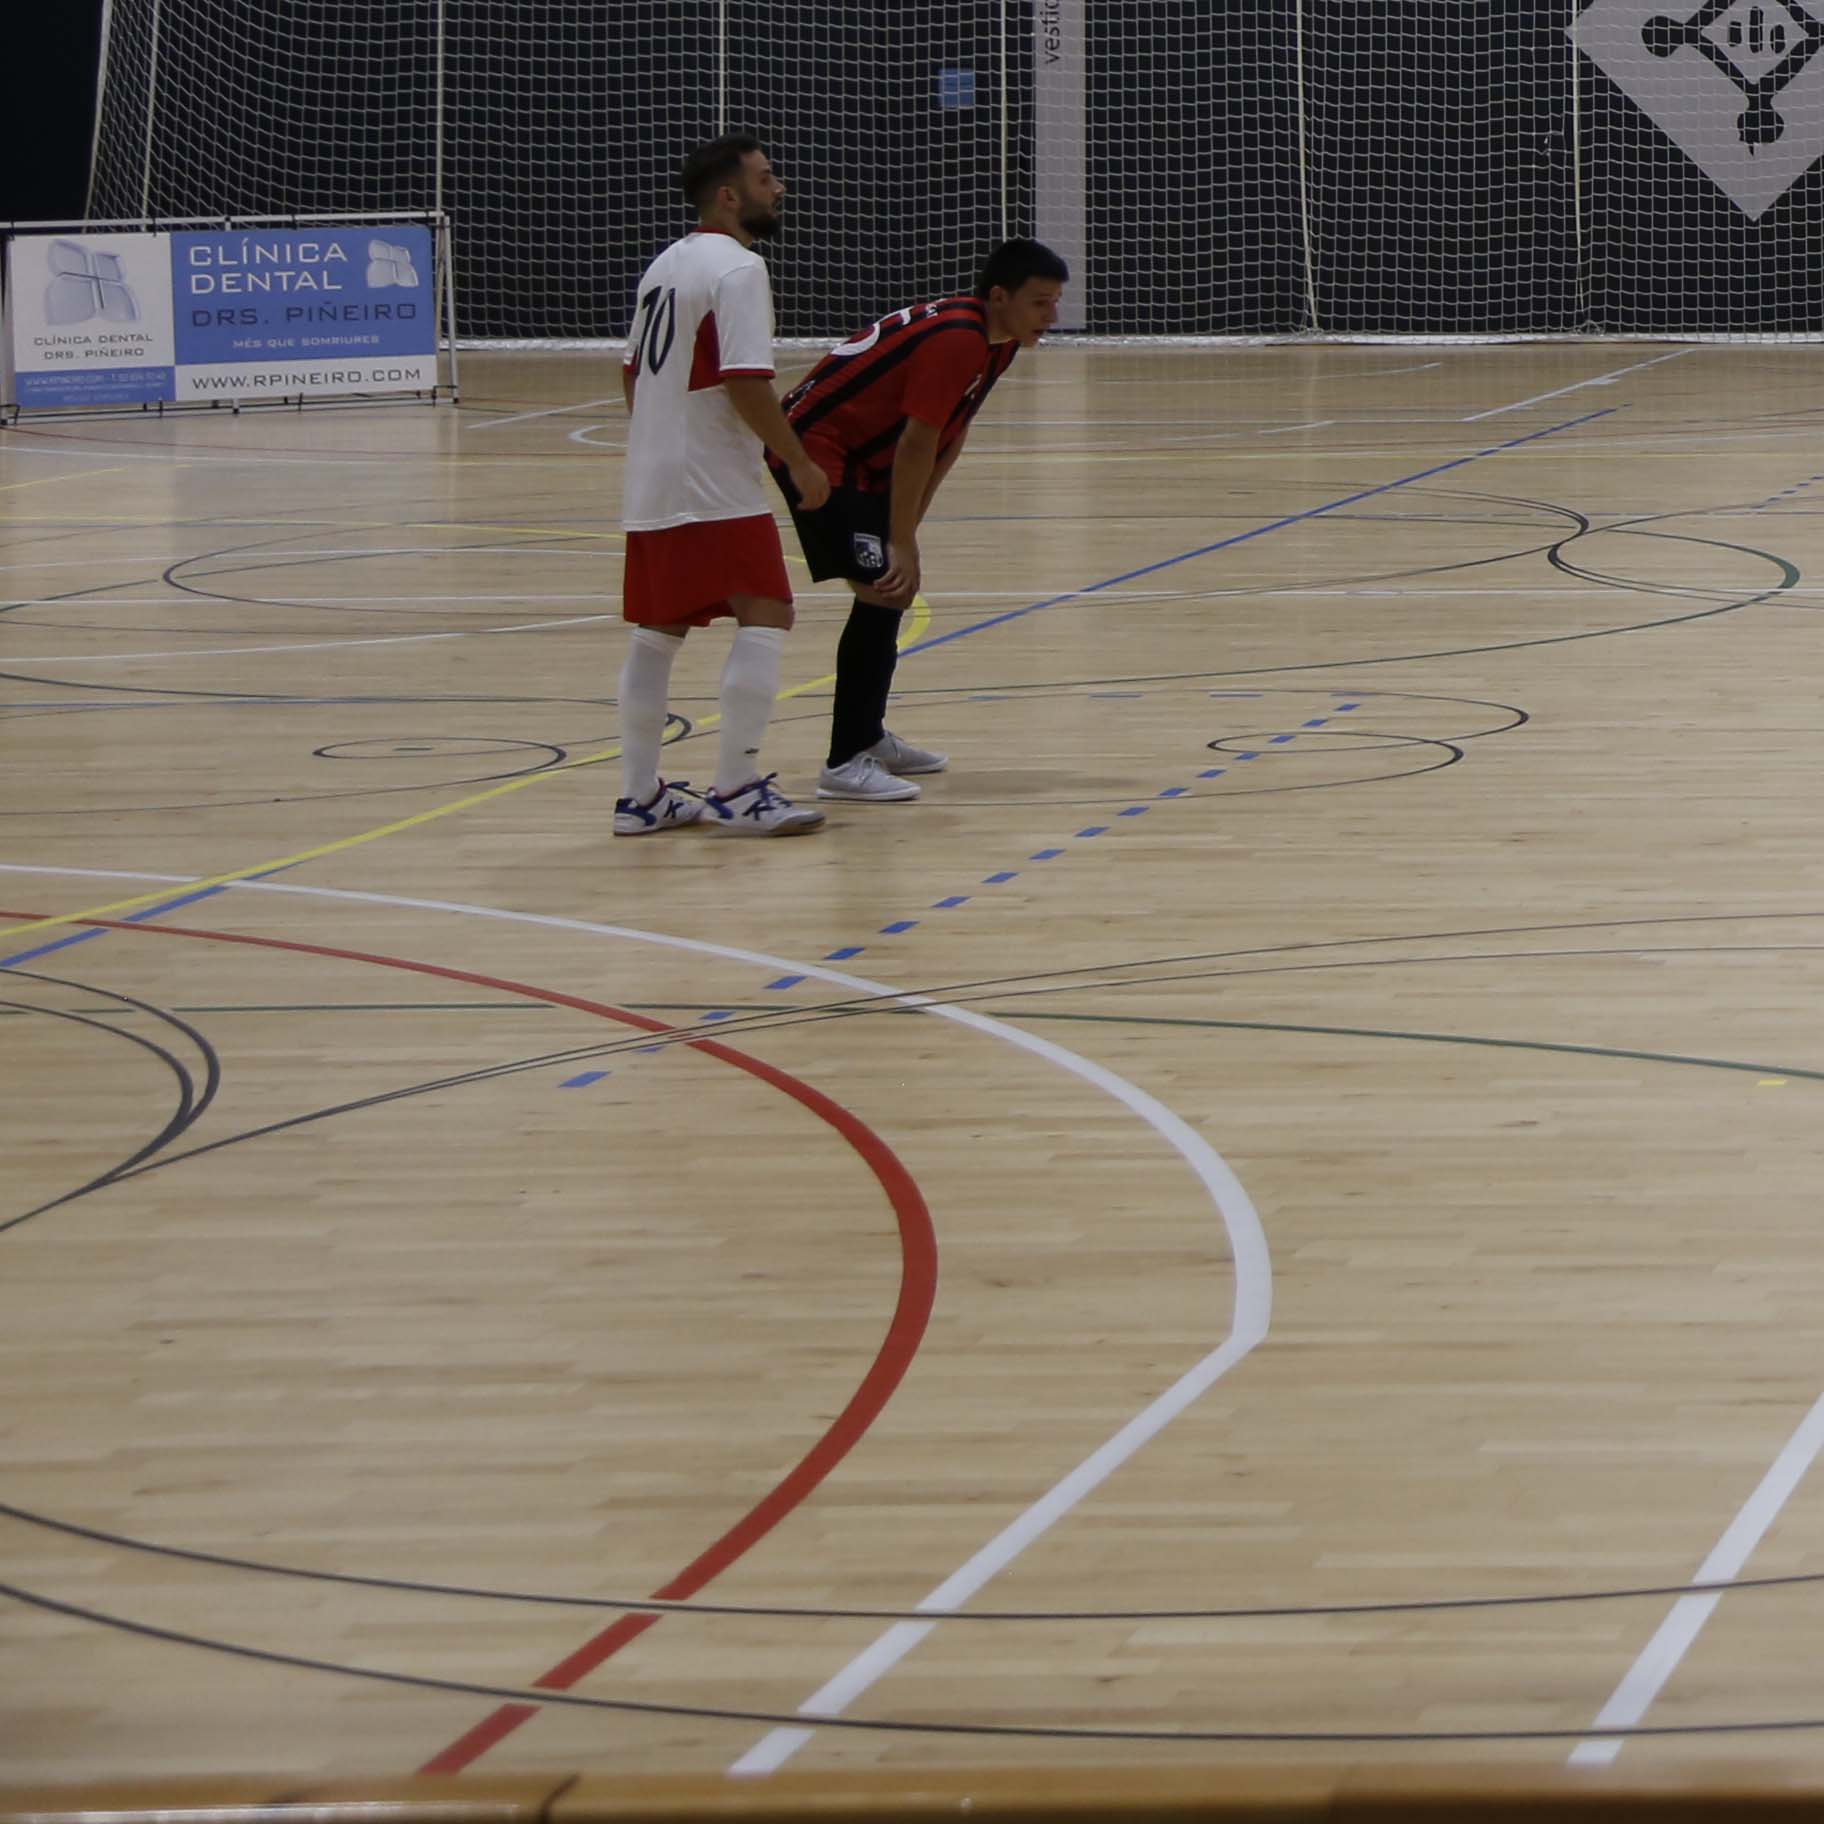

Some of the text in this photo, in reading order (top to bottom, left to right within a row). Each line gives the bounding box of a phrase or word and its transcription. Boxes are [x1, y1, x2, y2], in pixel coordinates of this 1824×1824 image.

[189, 238, 348, 266] CLÍNICA
[191, 271, 342, 294] DENTAL
[192, 301, 417, 326] DRS. PIÑEIRO
[34, 333, 153, 347] CLÍNICA DENTAL
[233, 335, 380, 348] MÉS QUE SOMRIURES
[637, 286, 676, 375] 10
[192, 368, 421, 389] WWW.RPINEIRO.COM
